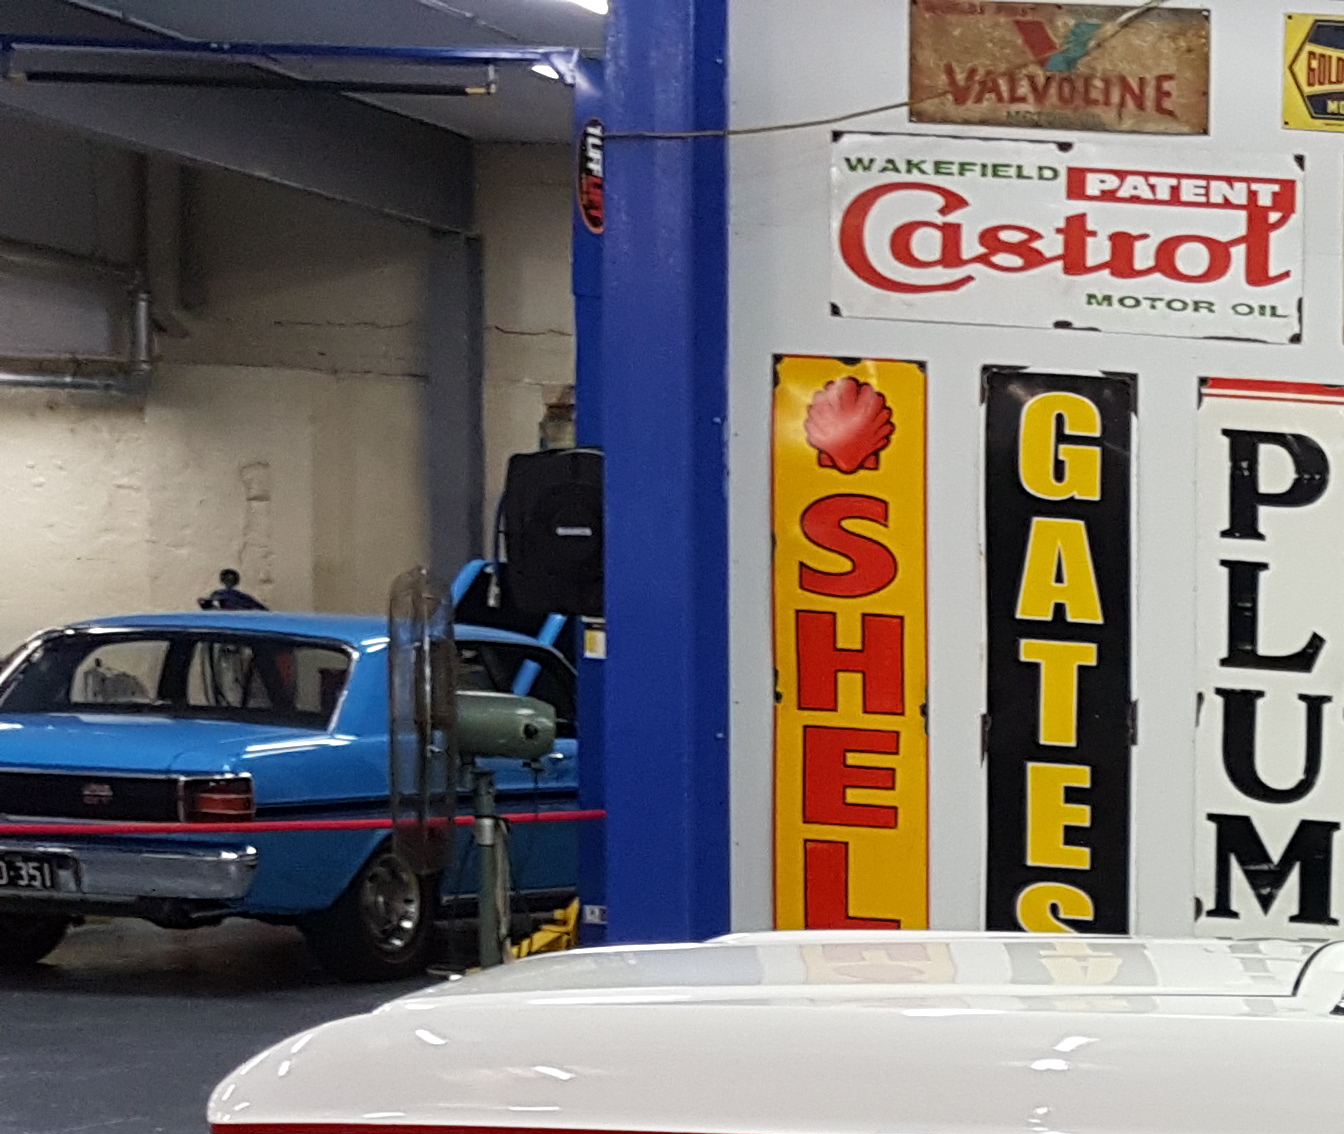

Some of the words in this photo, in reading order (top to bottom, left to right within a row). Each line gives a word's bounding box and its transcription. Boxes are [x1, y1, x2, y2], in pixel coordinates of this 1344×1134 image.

[944, 62, 1178, 119] VALVOLINE
[844, 157, 1060, 182] WAKEFIELD
[1084, 172, 1281, 208] PATENT
[839, 182, 1296, 294] Castrol
[1085, 292, 1217, 315] MOTOR
[1231, 301, 1289, 319] OIL
[1204, 428, 1341, 926] PLUM
[796, 492, 905, 929] SHEL
